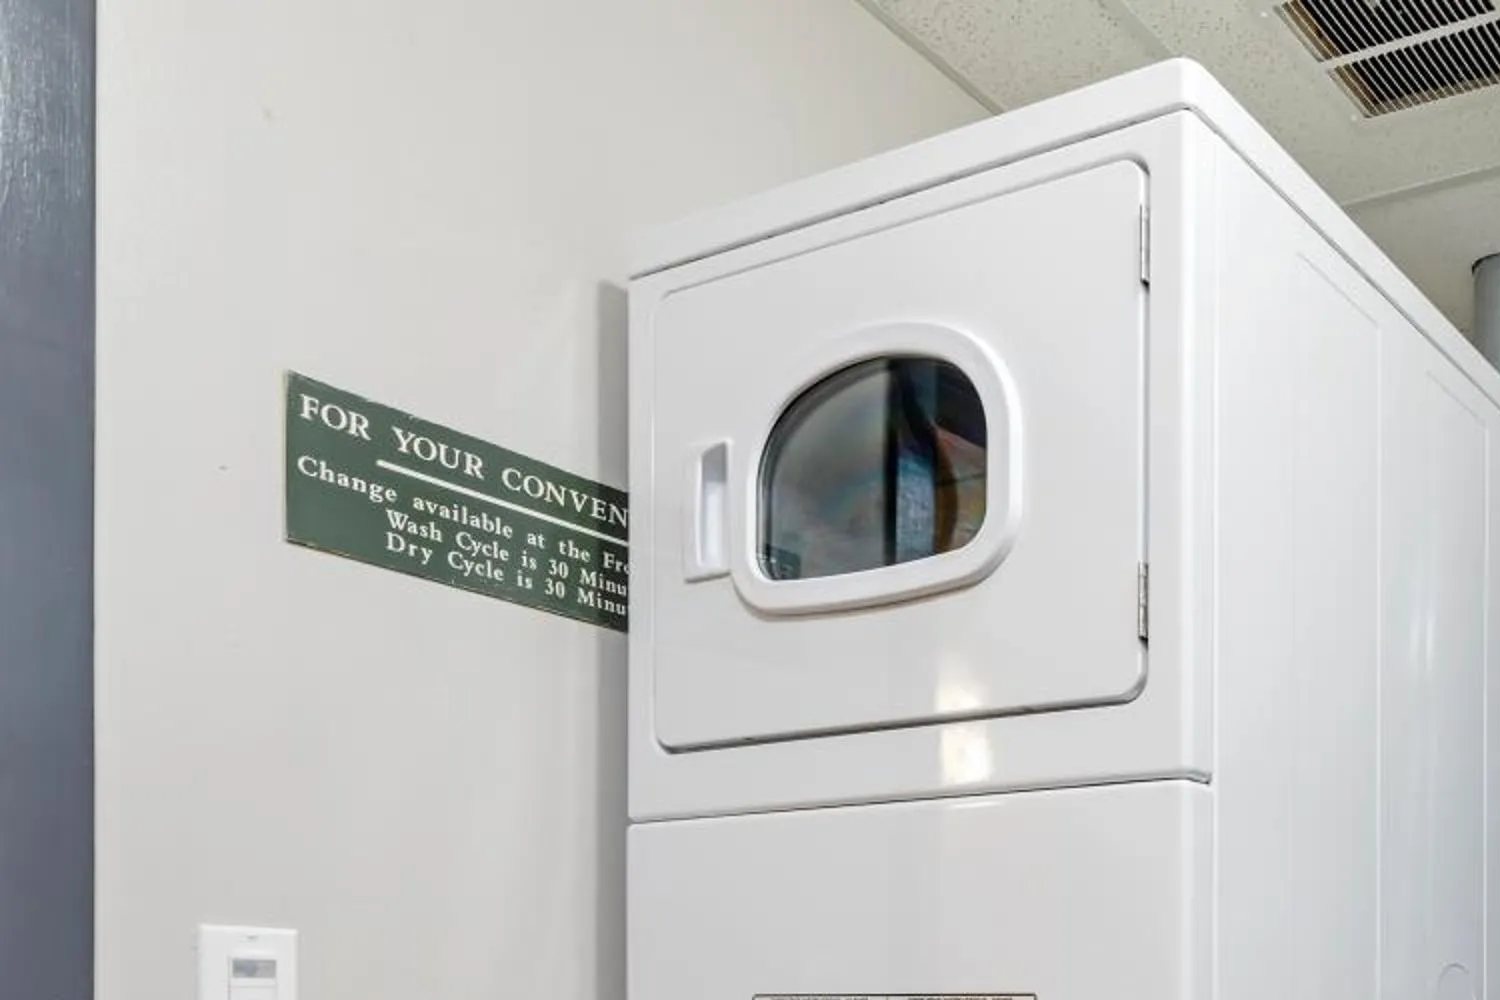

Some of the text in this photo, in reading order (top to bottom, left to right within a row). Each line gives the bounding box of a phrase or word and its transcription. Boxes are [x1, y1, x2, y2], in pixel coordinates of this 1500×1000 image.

[300, 394, 628, 529] FOR YOUR CONVEN
[297, 455, 397, 502] Change
[412, 495, 513, 539] available
[527, 530, 545, 549] at
[558, 539, 591, 563] the
[385, 508, 442, 542] Wash
[456, 531, 509, 561] Cycle
[521, 551, 537, 570] is
[548, 558, 569, 580] 30
[386, 533, 433, 565] Dry
[447, 551, 504, 583] Cycle
[516, 569, 533, 589] is
[544, 579, 565, 599] 30
